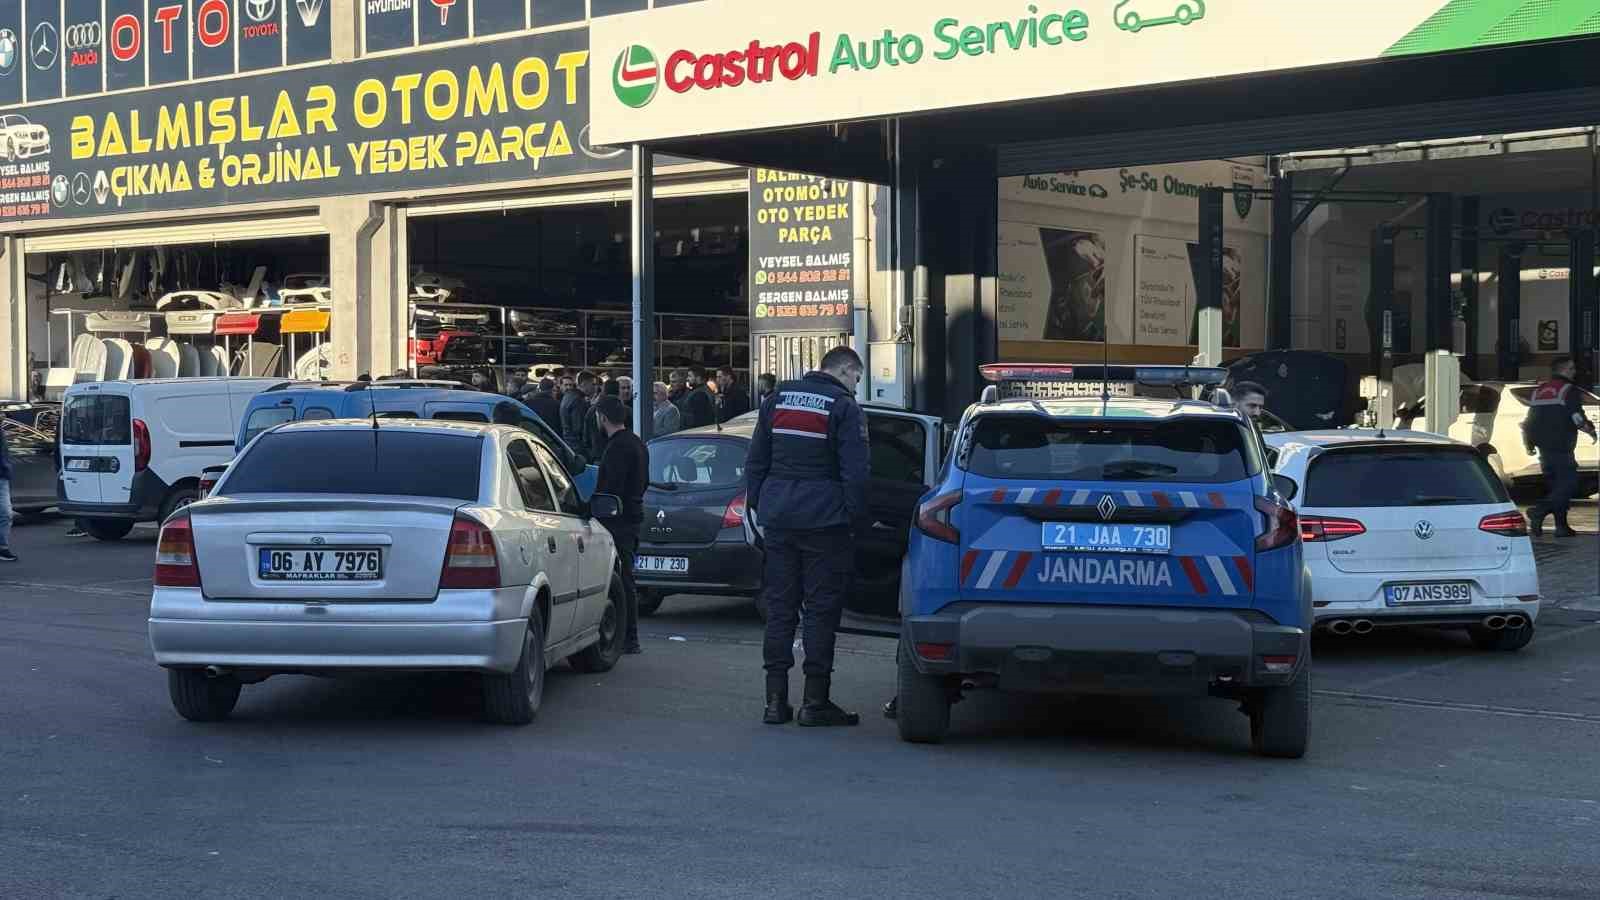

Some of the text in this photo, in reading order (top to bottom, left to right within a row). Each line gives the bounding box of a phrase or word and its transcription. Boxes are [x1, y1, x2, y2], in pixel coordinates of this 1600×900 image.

[242, 23, 279, 38] TOYOTA
[71, 51, 98, 67] Audi
[664, 5, 1090, 94] Castrol Auto Service
[70, 84, 337, 160] BALMIŞLAR
[20, 160, 50, 175] BALMIŞ
[110, 120, 574, 207] ÇIKMA & ORJİNAL YEDEK PARÇA
[1022, 175, 1087, 196] Auto Service
[1120, 168, 1158, 193] Şe-Sa
[20, 190, 50, 203] BALMIŞ
[757, 203, 848, 224] OTO YEDEK
[778, 226, 832, 245] PARÇA
[760, 253, 850, 269] VEYSEL BALMIŞ
[758, 290, 849, 303] SERGEN BALMIŞ
[1054, 524, 1167, 546] 21 JAA 730
[272, 552, 377, 572] 06 AY 7976
[639, 556, 686, 570] 21 DY 230
[1037, 557, 1173, 587] JANDARMA
[1394, 586, 1410, 601] 07
